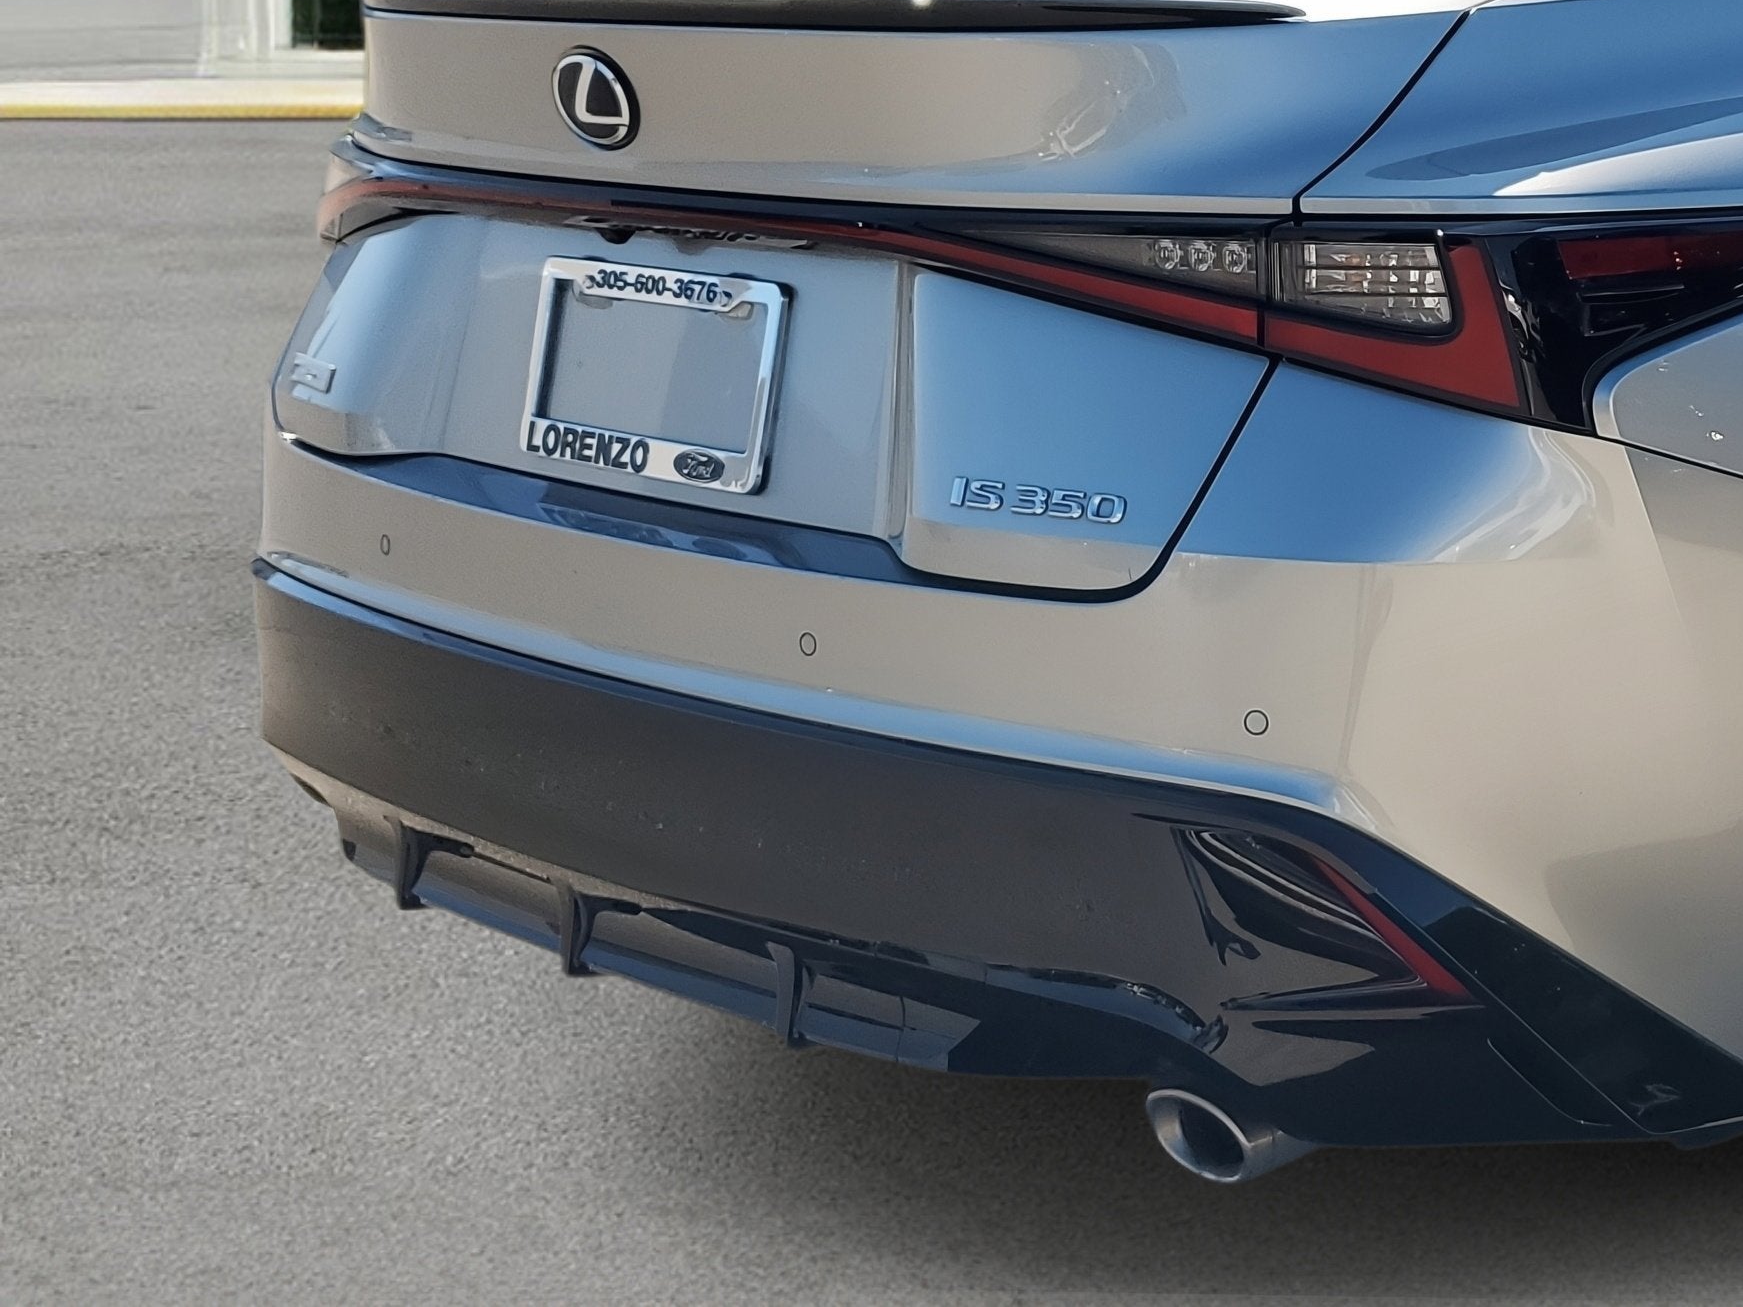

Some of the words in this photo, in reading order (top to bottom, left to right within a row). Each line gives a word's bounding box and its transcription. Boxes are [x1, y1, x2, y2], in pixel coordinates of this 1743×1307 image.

[595, 269, 719, 302] 305-600-3676
[526, 421, 650, 473] LORENZO
[949, 476, 1006, 511] IS
[1010, 483, 1128, 524] 350
